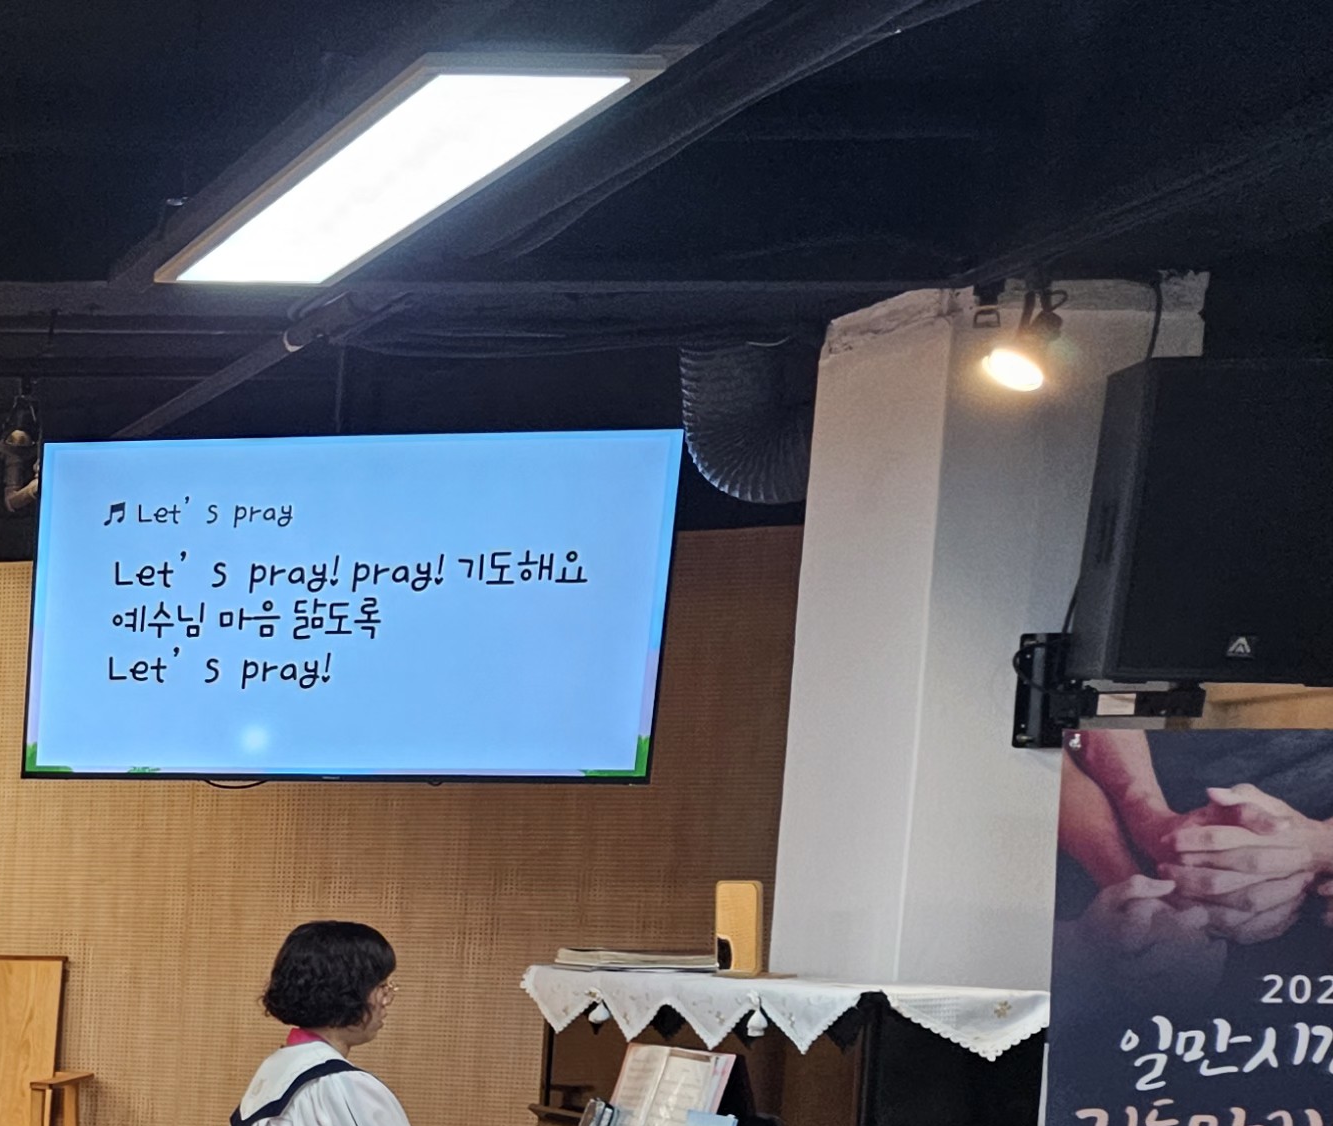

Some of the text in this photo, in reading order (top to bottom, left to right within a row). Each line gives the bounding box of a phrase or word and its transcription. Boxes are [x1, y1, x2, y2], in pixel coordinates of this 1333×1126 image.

[233, 504, 293, 529] pray
[248, 554, 340, 594] pray!
[351, 553, 445, 593] pray!
[457, 549, 588, 585] 기도해요
[112, 597, 382, 640] 예수님 마음 닮도록
[241, 652, 332, 690] pray!
